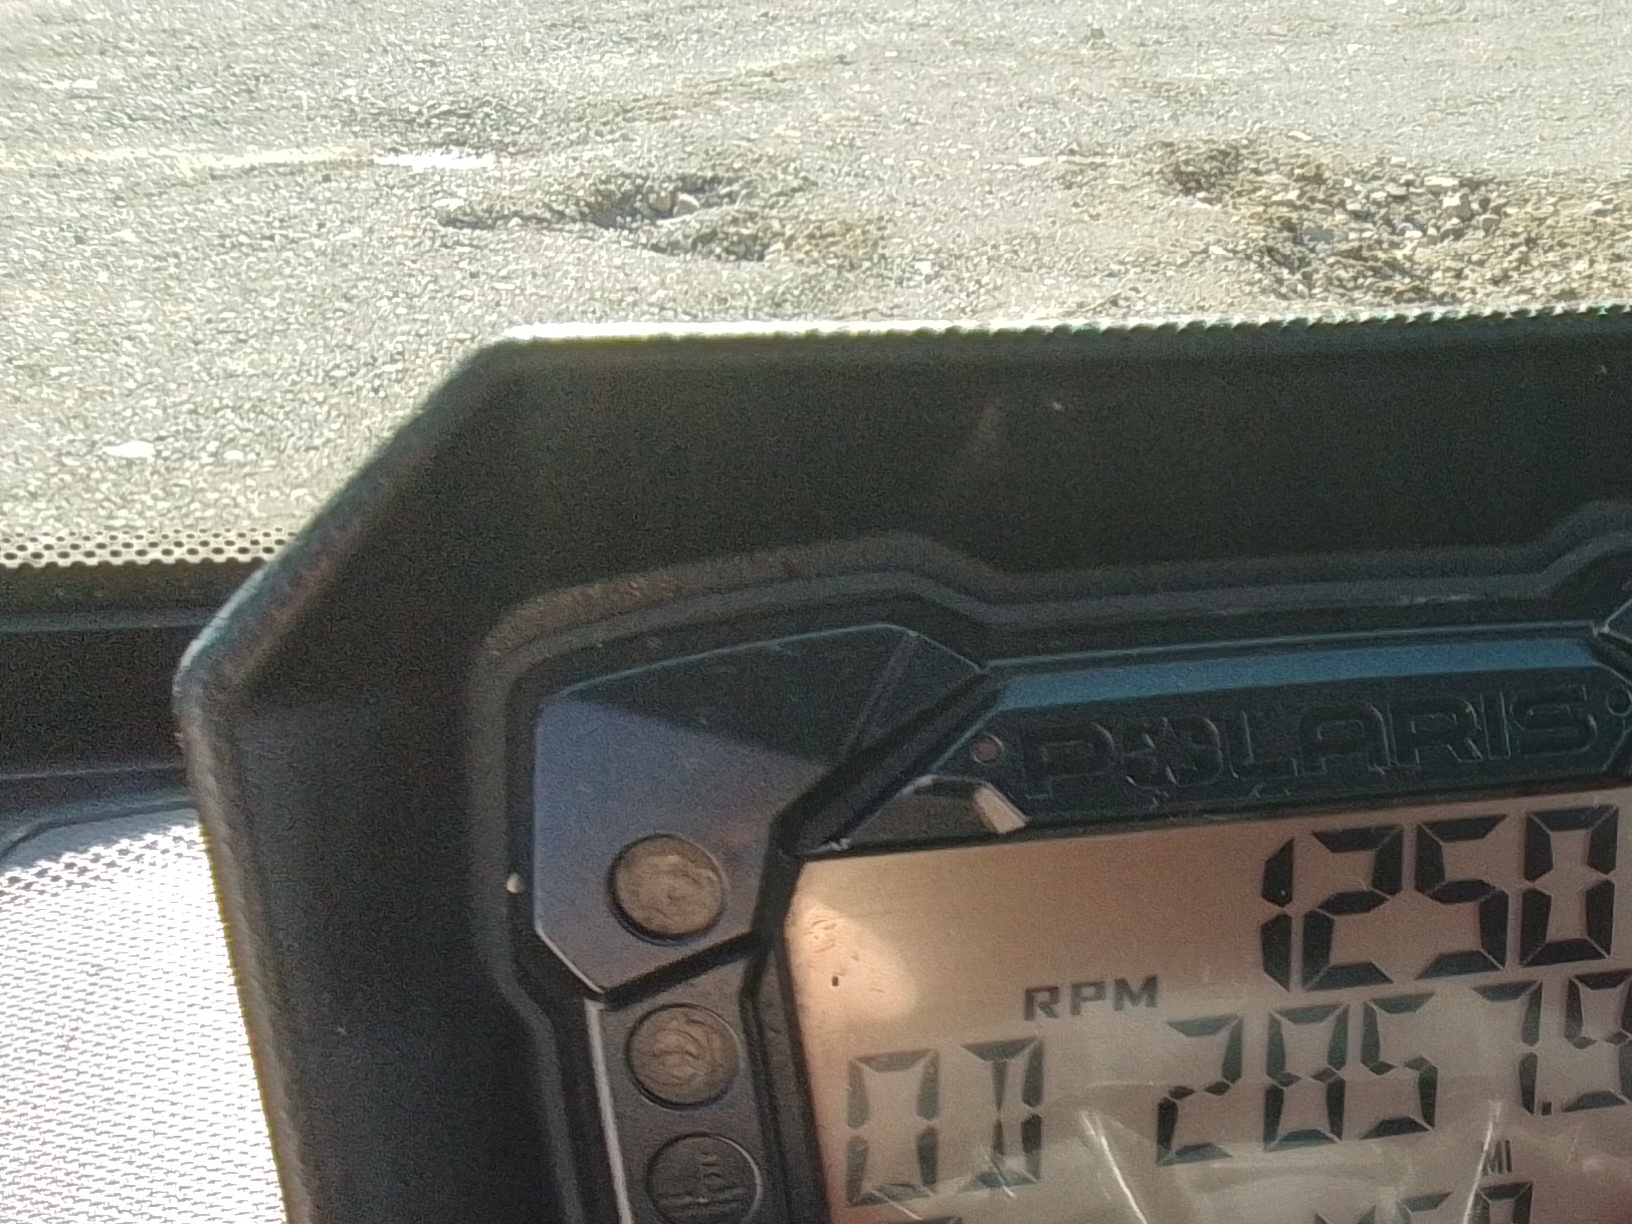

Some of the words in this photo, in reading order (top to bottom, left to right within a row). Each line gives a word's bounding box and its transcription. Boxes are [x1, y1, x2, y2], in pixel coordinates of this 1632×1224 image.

[1022, 685, 1598, 799] POLARIS
[1261, 804, 1619, 993] 1250
[1024, 975, 1158, 1021] RPM
